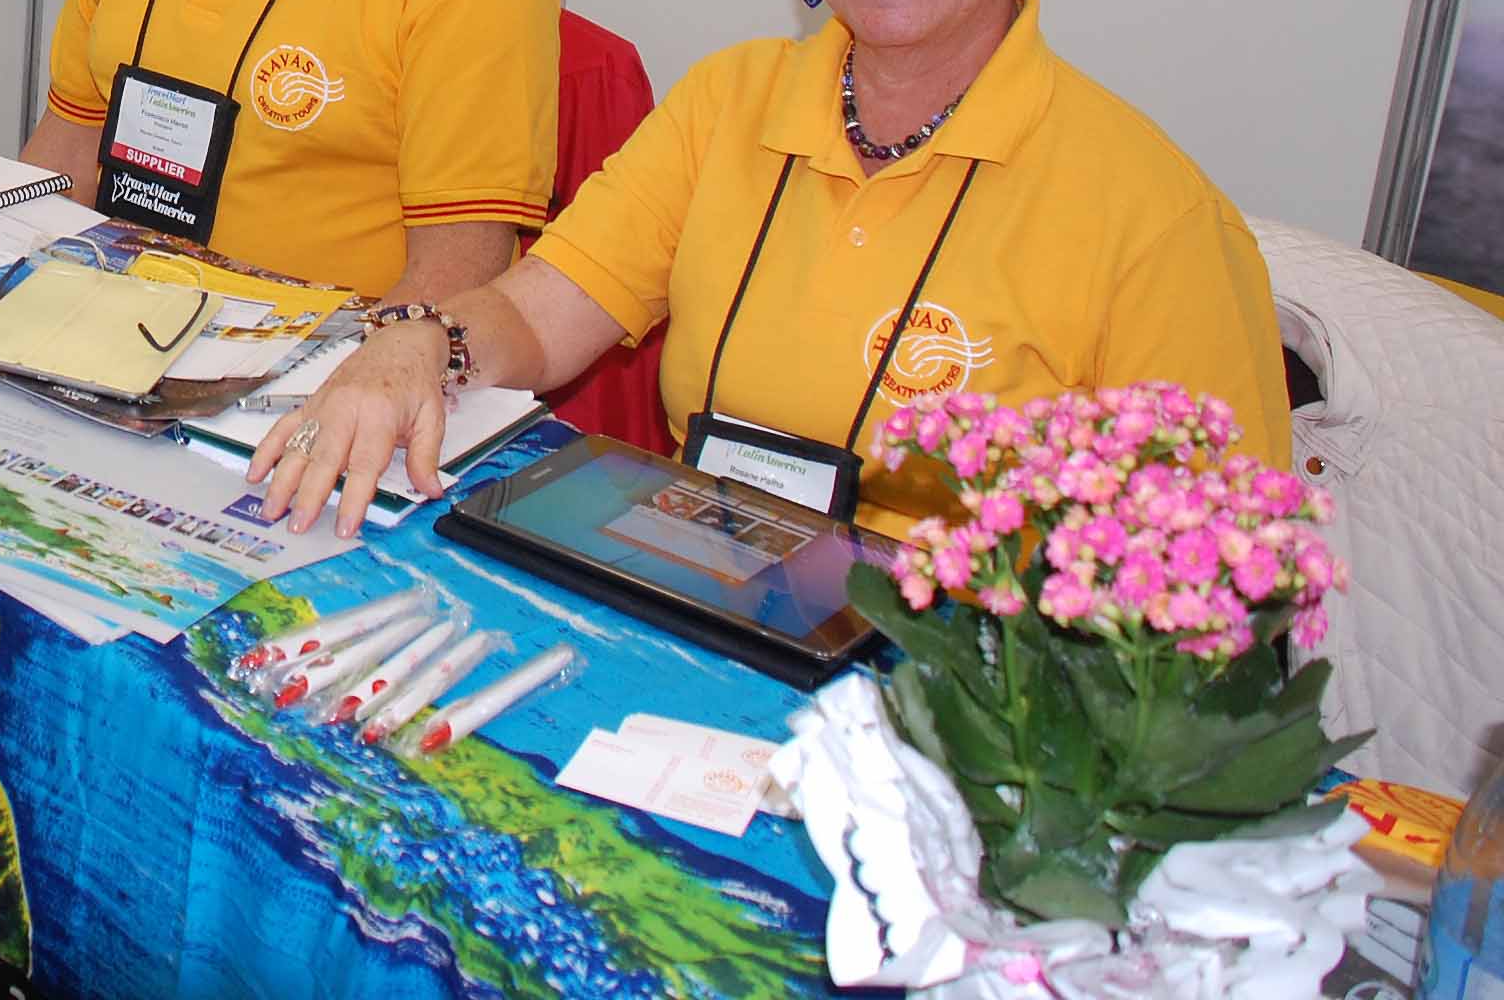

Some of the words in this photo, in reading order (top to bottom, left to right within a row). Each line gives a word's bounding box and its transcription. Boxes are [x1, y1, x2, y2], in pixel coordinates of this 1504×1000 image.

[257, 53, 314, 83] HAVAS
[258, 95, 291, 122] CREATIVE
[294, 97, 319, 120] TOURS
[126, 148, 186, 180] SUPPLIER
